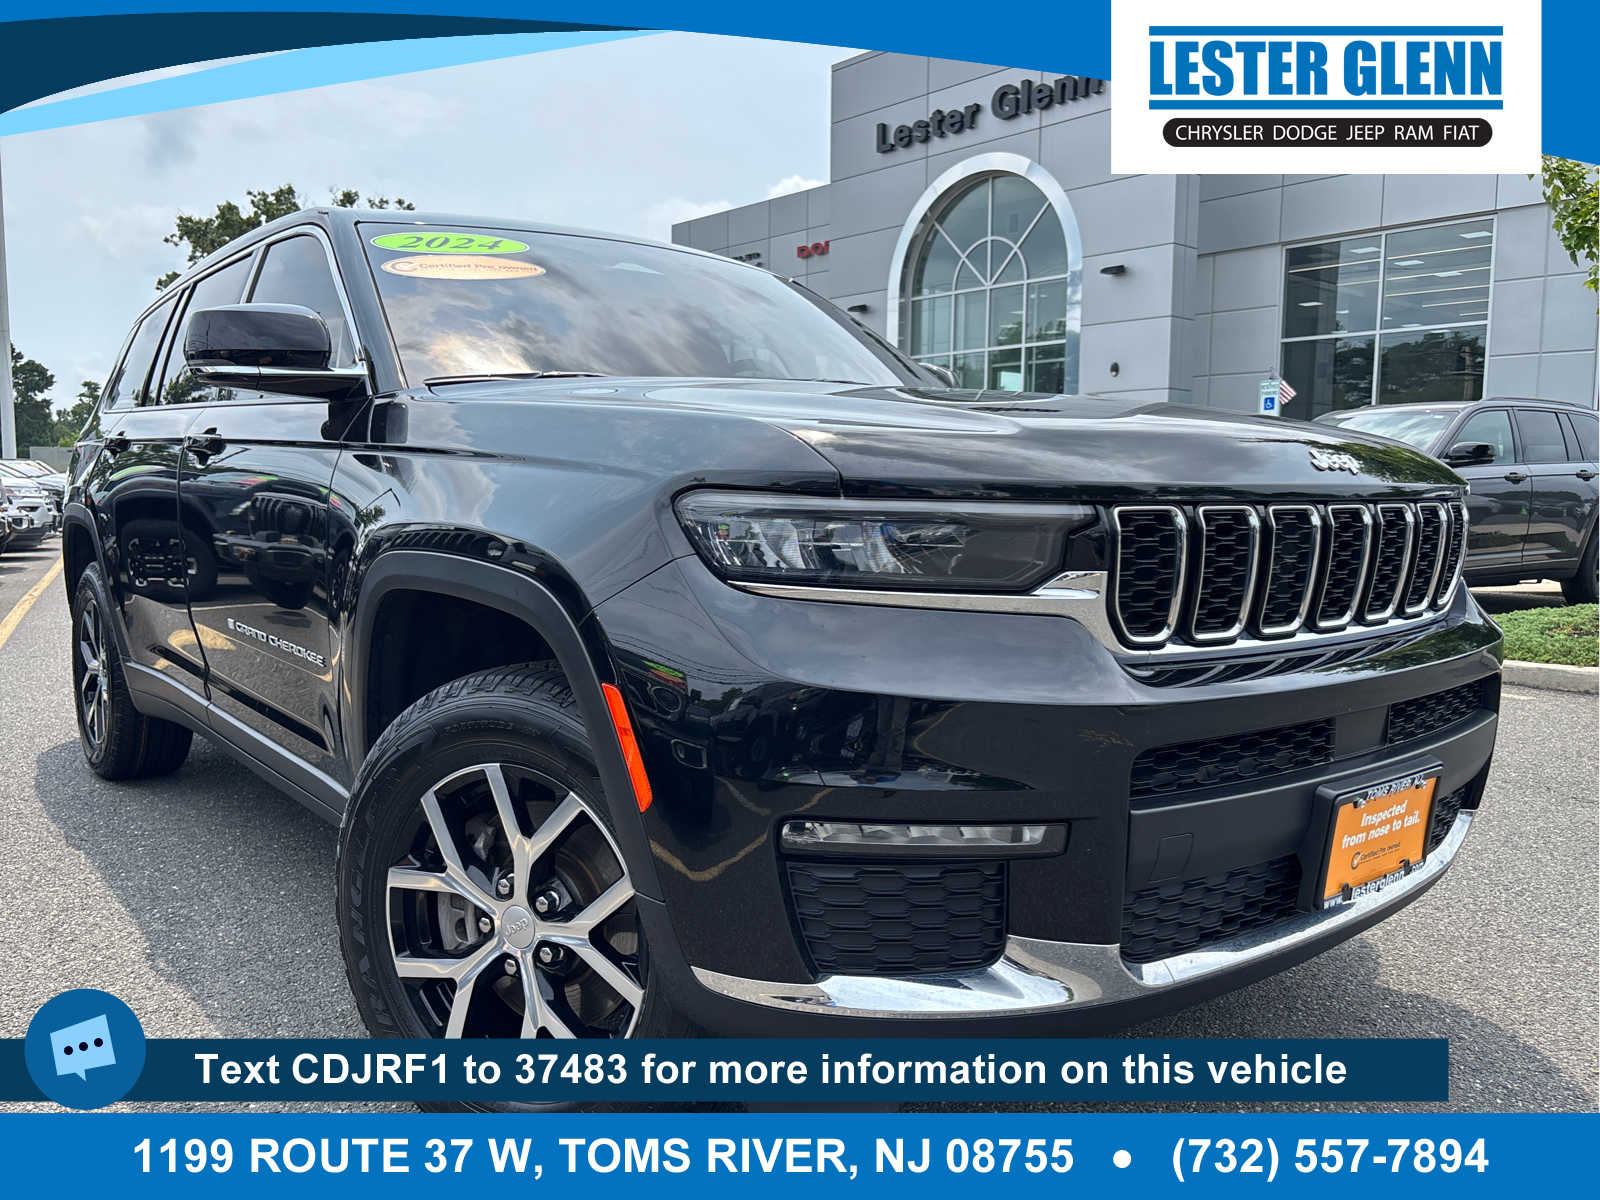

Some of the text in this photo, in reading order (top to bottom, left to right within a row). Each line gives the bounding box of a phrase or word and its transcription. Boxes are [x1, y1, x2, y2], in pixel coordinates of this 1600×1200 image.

[876, 102, 981, 154] Lester
[399, 235, 505, 251] 2024
[1309, 448, 1359, 475] Jeep
[235, 620, 326, 668] GRAND CHEROKEE
[1360, 800, 1408, 828] Inspected
[1342, 809, 1421, 849] from nose to tail.
[505, 918, 529, 937] Jeep
